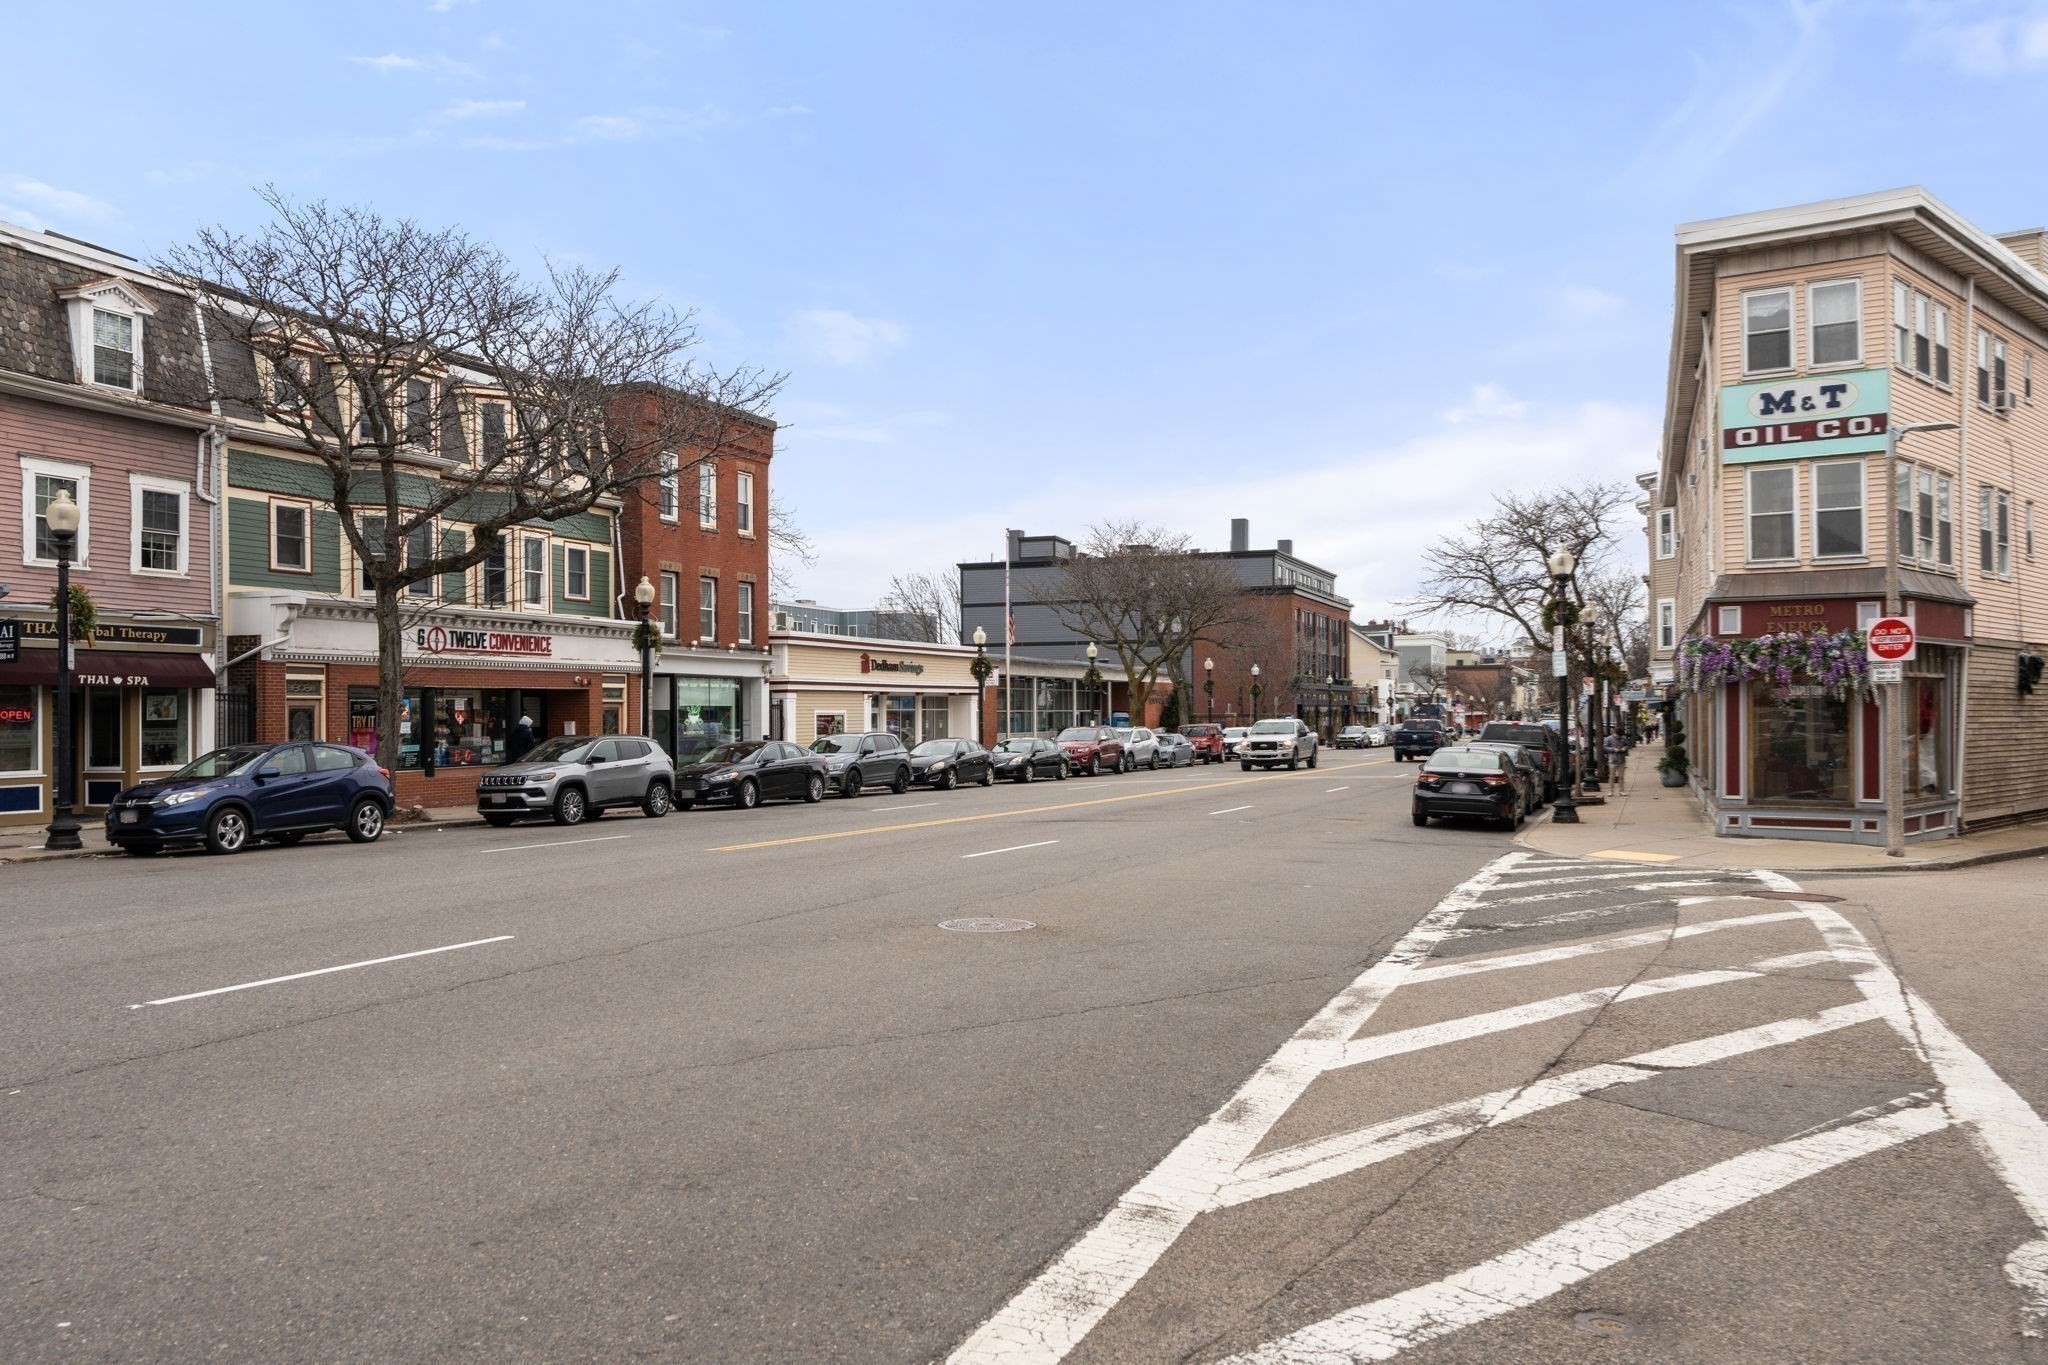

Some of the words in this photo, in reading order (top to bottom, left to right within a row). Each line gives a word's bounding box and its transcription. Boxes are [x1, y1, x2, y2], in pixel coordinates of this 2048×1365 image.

[1735, 424, 1802, 446] OIL
[1816, 417, 1882, 438] CO.
[1769, 604, 1825, 617] METRO
[23, 622, 59, 634] THA
[120, 627, 168, 642] Therapy
[1874, 628, 1888, 636] DO
[1890, 627, 1907, 635] NOT
[417, 628, 425, 647] 6
[449, 630, 487, 649] TWELVE
[489, 633, 552, 652] CONVENIENCE
[1878, 643, 1905, 651] ENTER
[871, 658, 899, 672] Dedham
[899, 661, 924, 676] Savings
[78, 674, 109, 685] THAI
[127, 675, 149, 686] SPA
[0, 710, 31, 720] OPEN
[352, 715, 367, 728] TRY
[368, 715, 375, 728] IT
